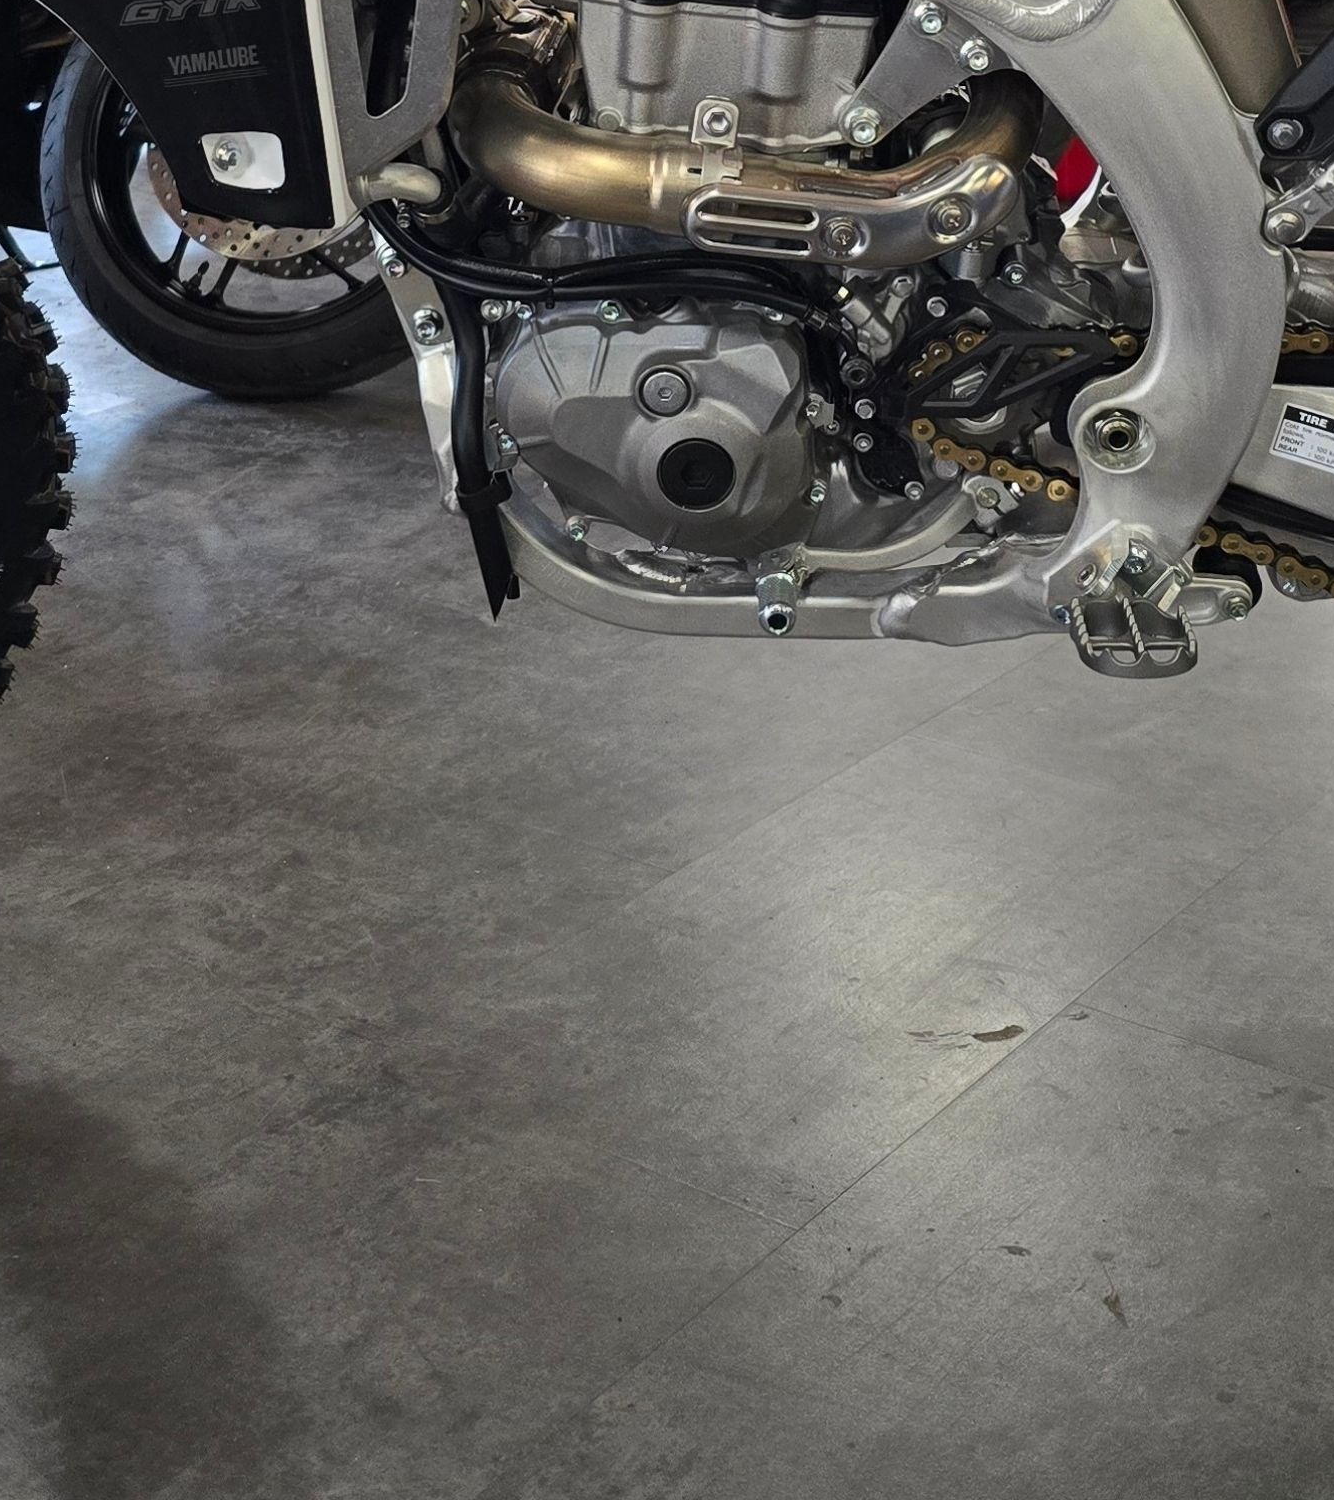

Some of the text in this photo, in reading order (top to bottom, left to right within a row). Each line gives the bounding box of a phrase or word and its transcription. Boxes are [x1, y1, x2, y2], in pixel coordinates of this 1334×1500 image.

[168, 44, 260, 77] YAMALUBE
[1298, 411, 1328, 429] TIRE
[1280, 435, 1305, 448] FRONT
